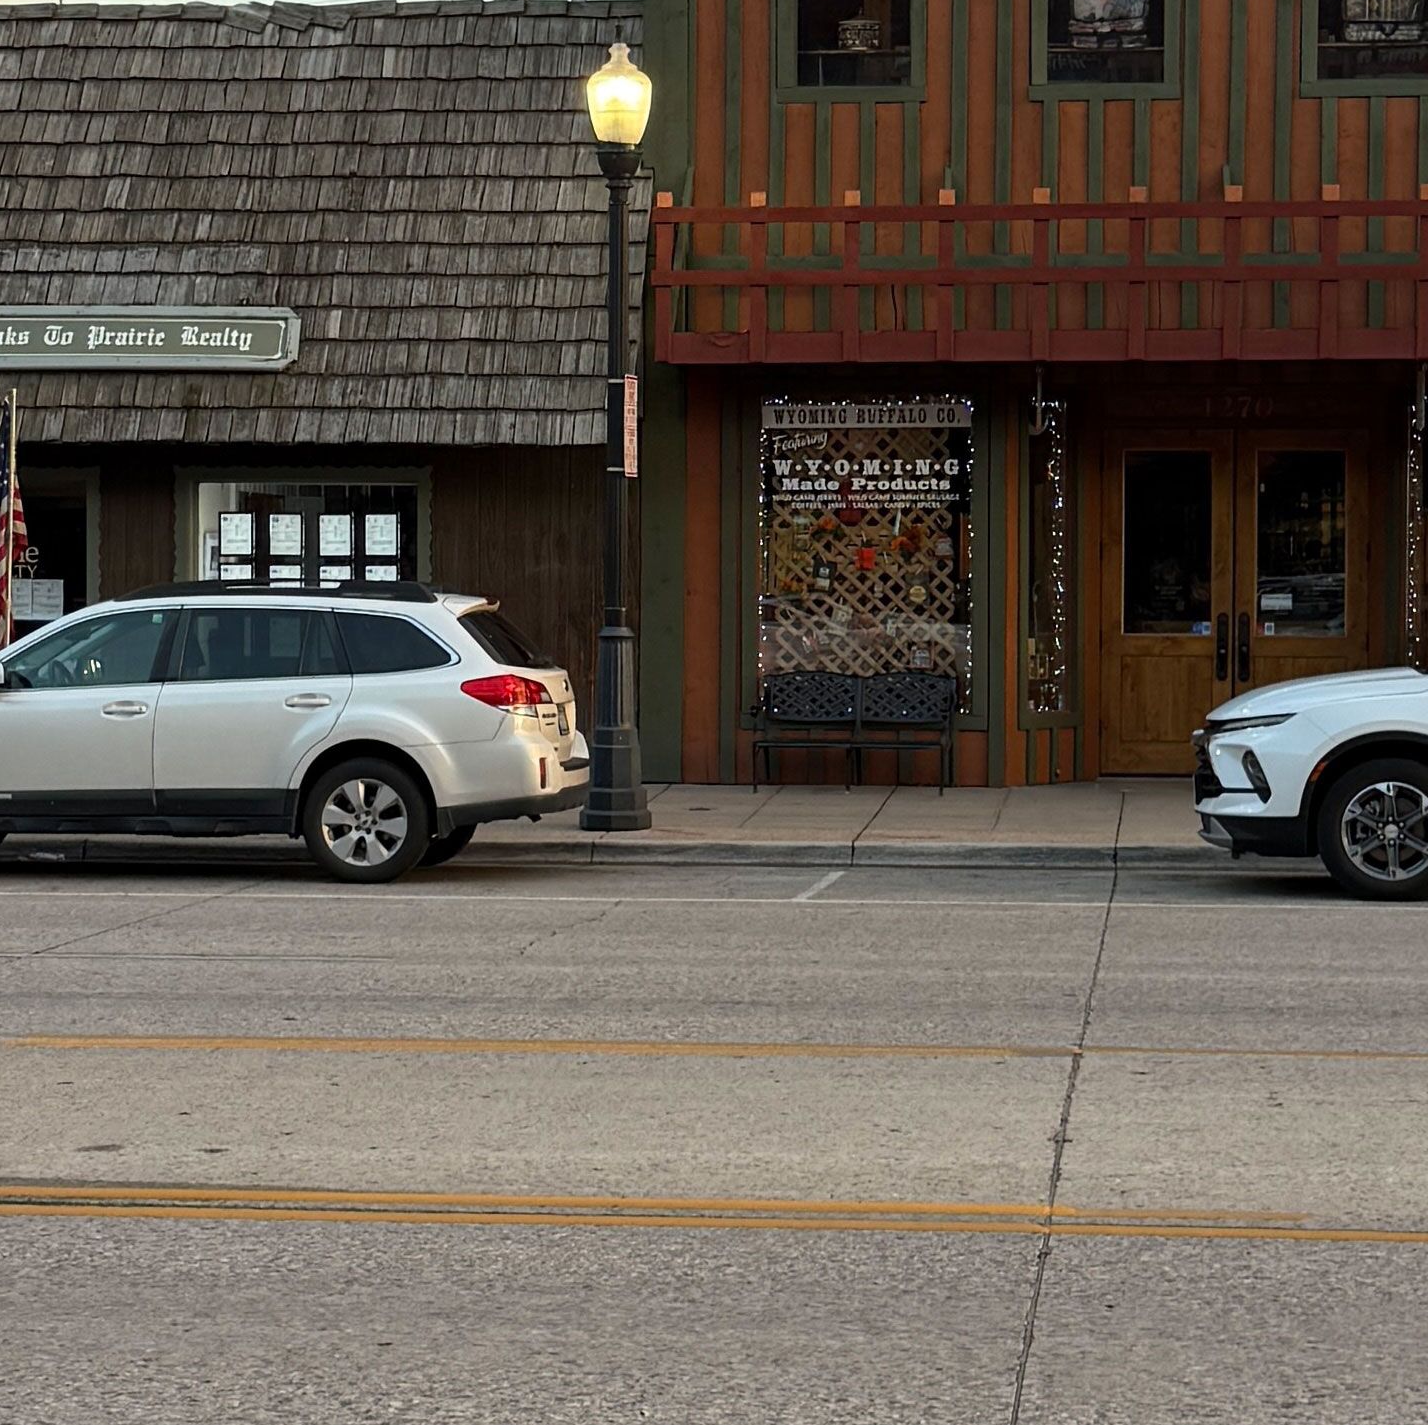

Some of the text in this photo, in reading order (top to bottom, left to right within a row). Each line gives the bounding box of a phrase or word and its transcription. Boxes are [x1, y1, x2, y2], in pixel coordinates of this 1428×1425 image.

[44, 326, 74, 346] To
[87, 325, 165, 350] Prairie
[181, 326, 253, 351] Realty
[773, 407, 961, 424] WYOMING BUFFALO CO.
[772, 431, 828, 455] Featuring
[782, 477, 951, 491] Made Products
